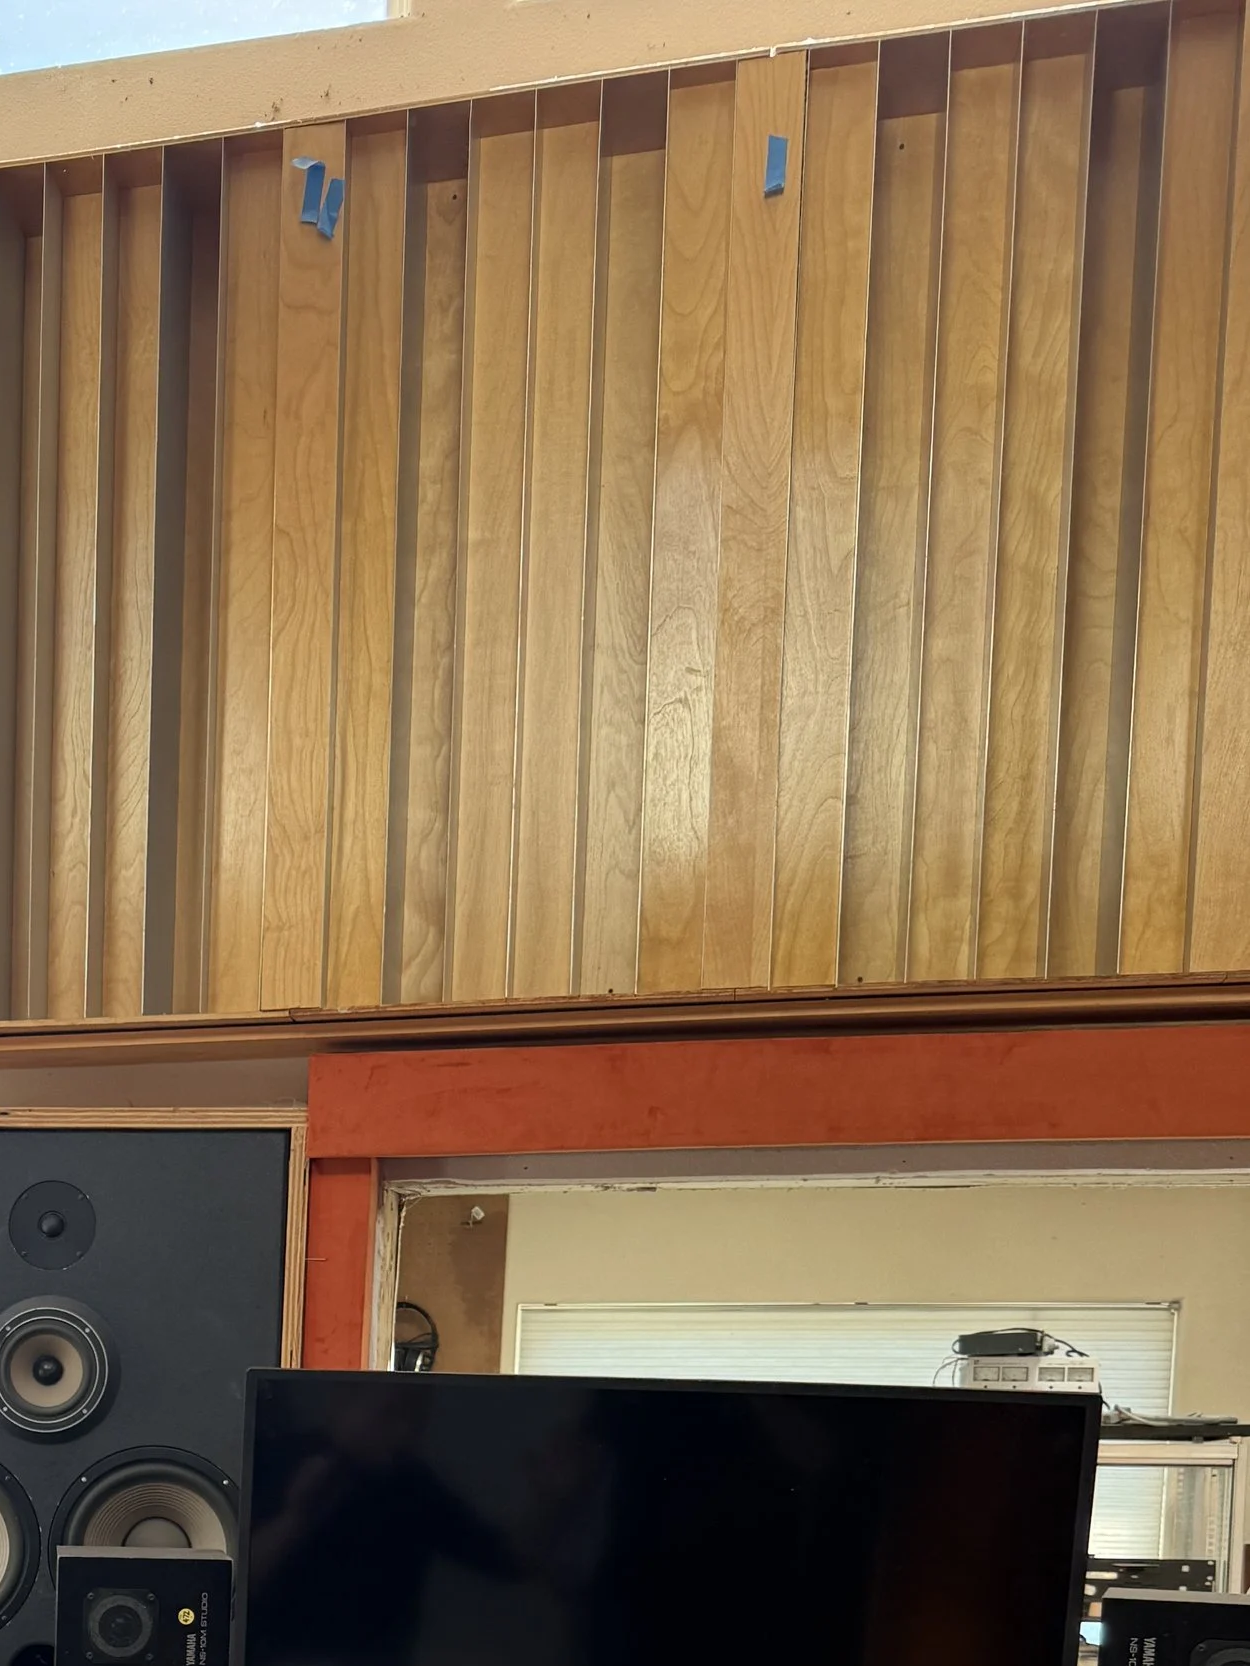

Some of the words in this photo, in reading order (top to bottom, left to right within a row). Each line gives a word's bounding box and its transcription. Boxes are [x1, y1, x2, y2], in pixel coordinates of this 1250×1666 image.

[182, 1610, 190, 1623] 472
[200, 1592, 208, 1628] STUDIO
[186, 1633, 196, 1666] YAMAHA
